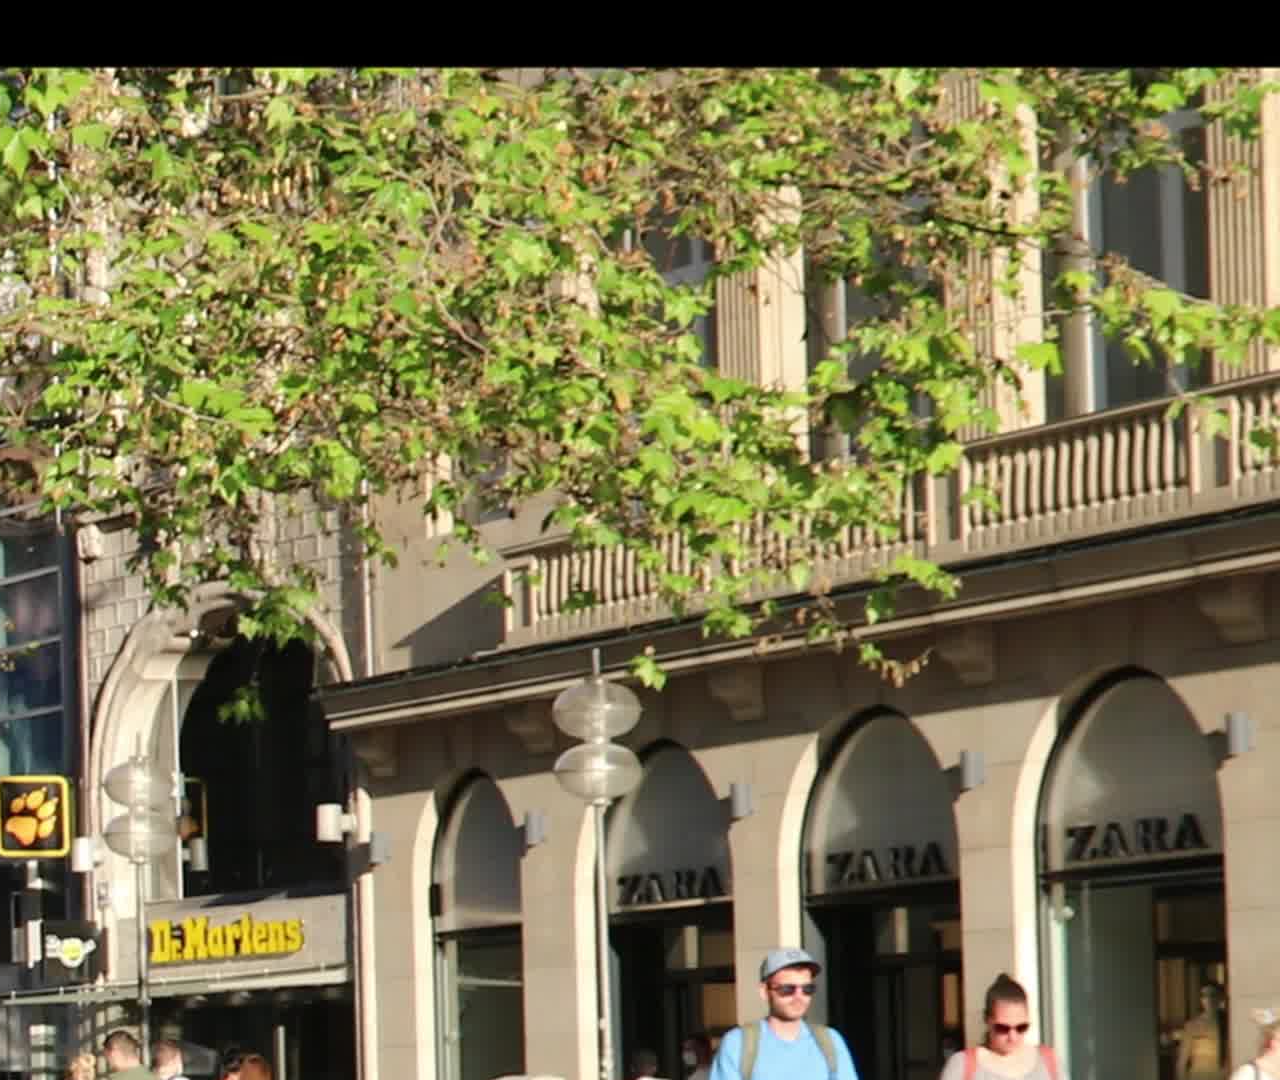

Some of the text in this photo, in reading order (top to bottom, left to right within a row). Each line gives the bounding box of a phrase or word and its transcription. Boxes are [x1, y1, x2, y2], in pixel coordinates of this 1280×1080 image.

[1065, 813, 1211, 860] ZARA
[826, 842, 948, 883] ZARA
[617, 866, 723, 903] ZARA
